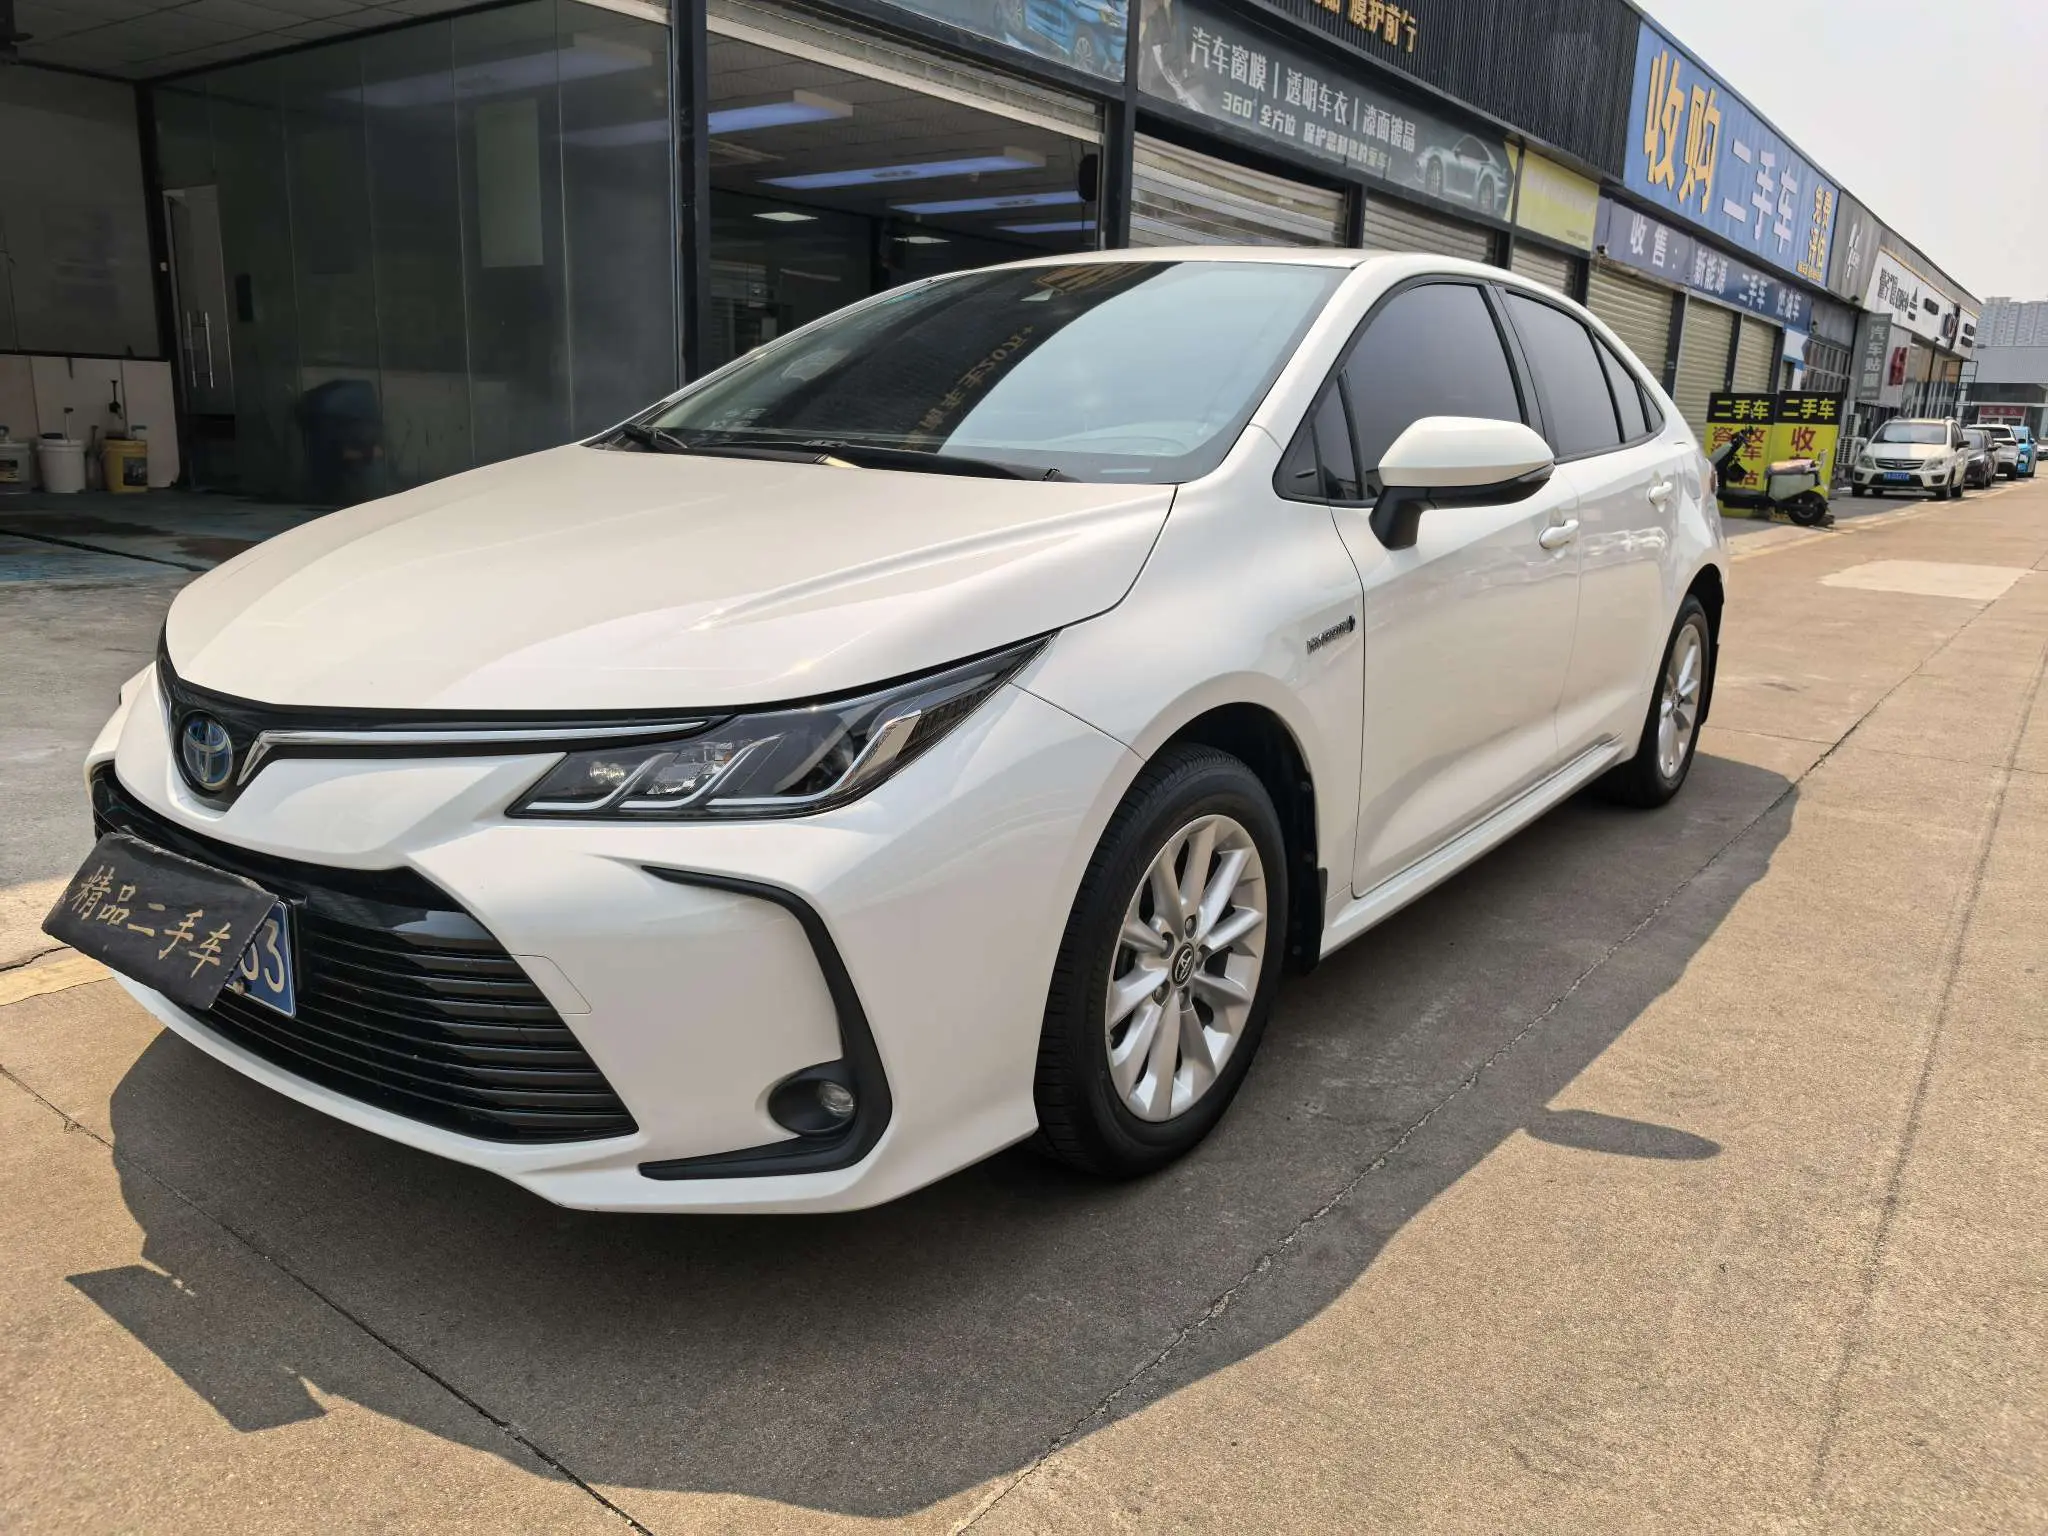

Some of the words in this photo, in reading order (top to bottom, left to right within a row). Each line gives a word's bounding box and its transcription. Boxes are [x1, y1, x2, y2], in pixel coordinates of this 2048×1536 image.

[1348, 0, 1416, 53] 膜护前行
[1190, 25, 1267, 93] 汽车窗膜
[1285, 67, 1349, 126] 透明车衣
[1362, 103, 1416, 153] 漆面镀晶
[1258, 104, 1297, 137] 全方位
[1738, 272, 1768, 311] 二手车
[1714, 399, 1770, 420] 二手车
[1782, 397, 1836, 420] 二手车
[71, 864, 233, 979] 精品二手车
